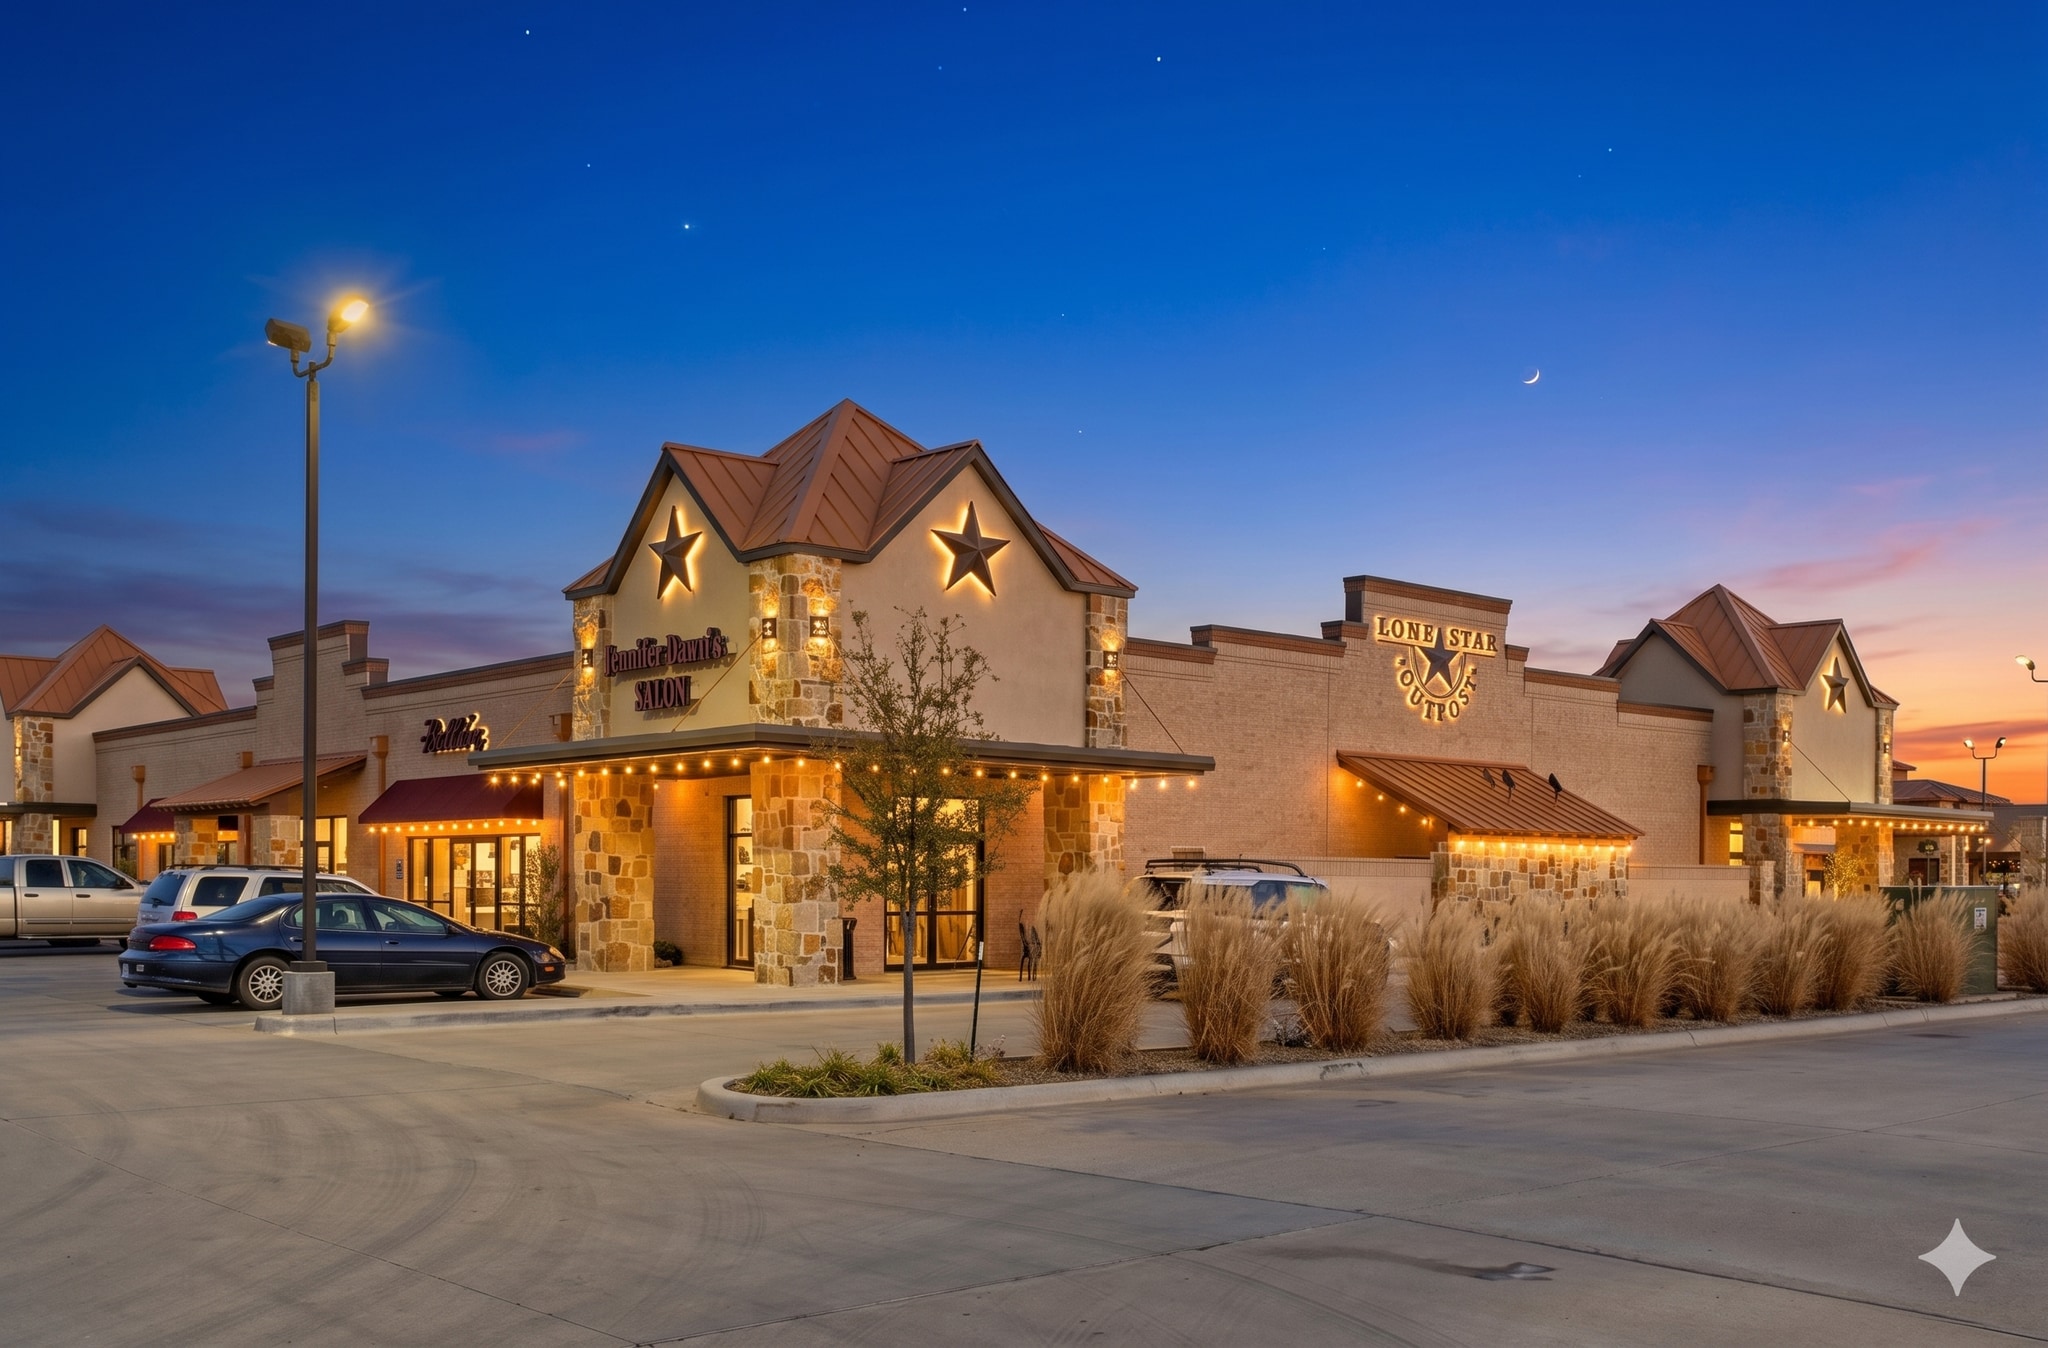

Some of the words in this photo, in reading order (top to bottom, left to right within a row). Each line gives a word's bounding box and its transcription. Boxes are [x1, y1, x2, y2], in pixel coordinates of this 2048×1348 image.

[604, 636, 666, 677] Jennifer
[666, 627, 727, 665] Dawn's
[1377, 616, 1434, 643] LONE
[1449, 628, 1498, 652] STAR
[634, 675, 692, 711] SALON
[1400, 669, 1477, 721] OUTPOST
